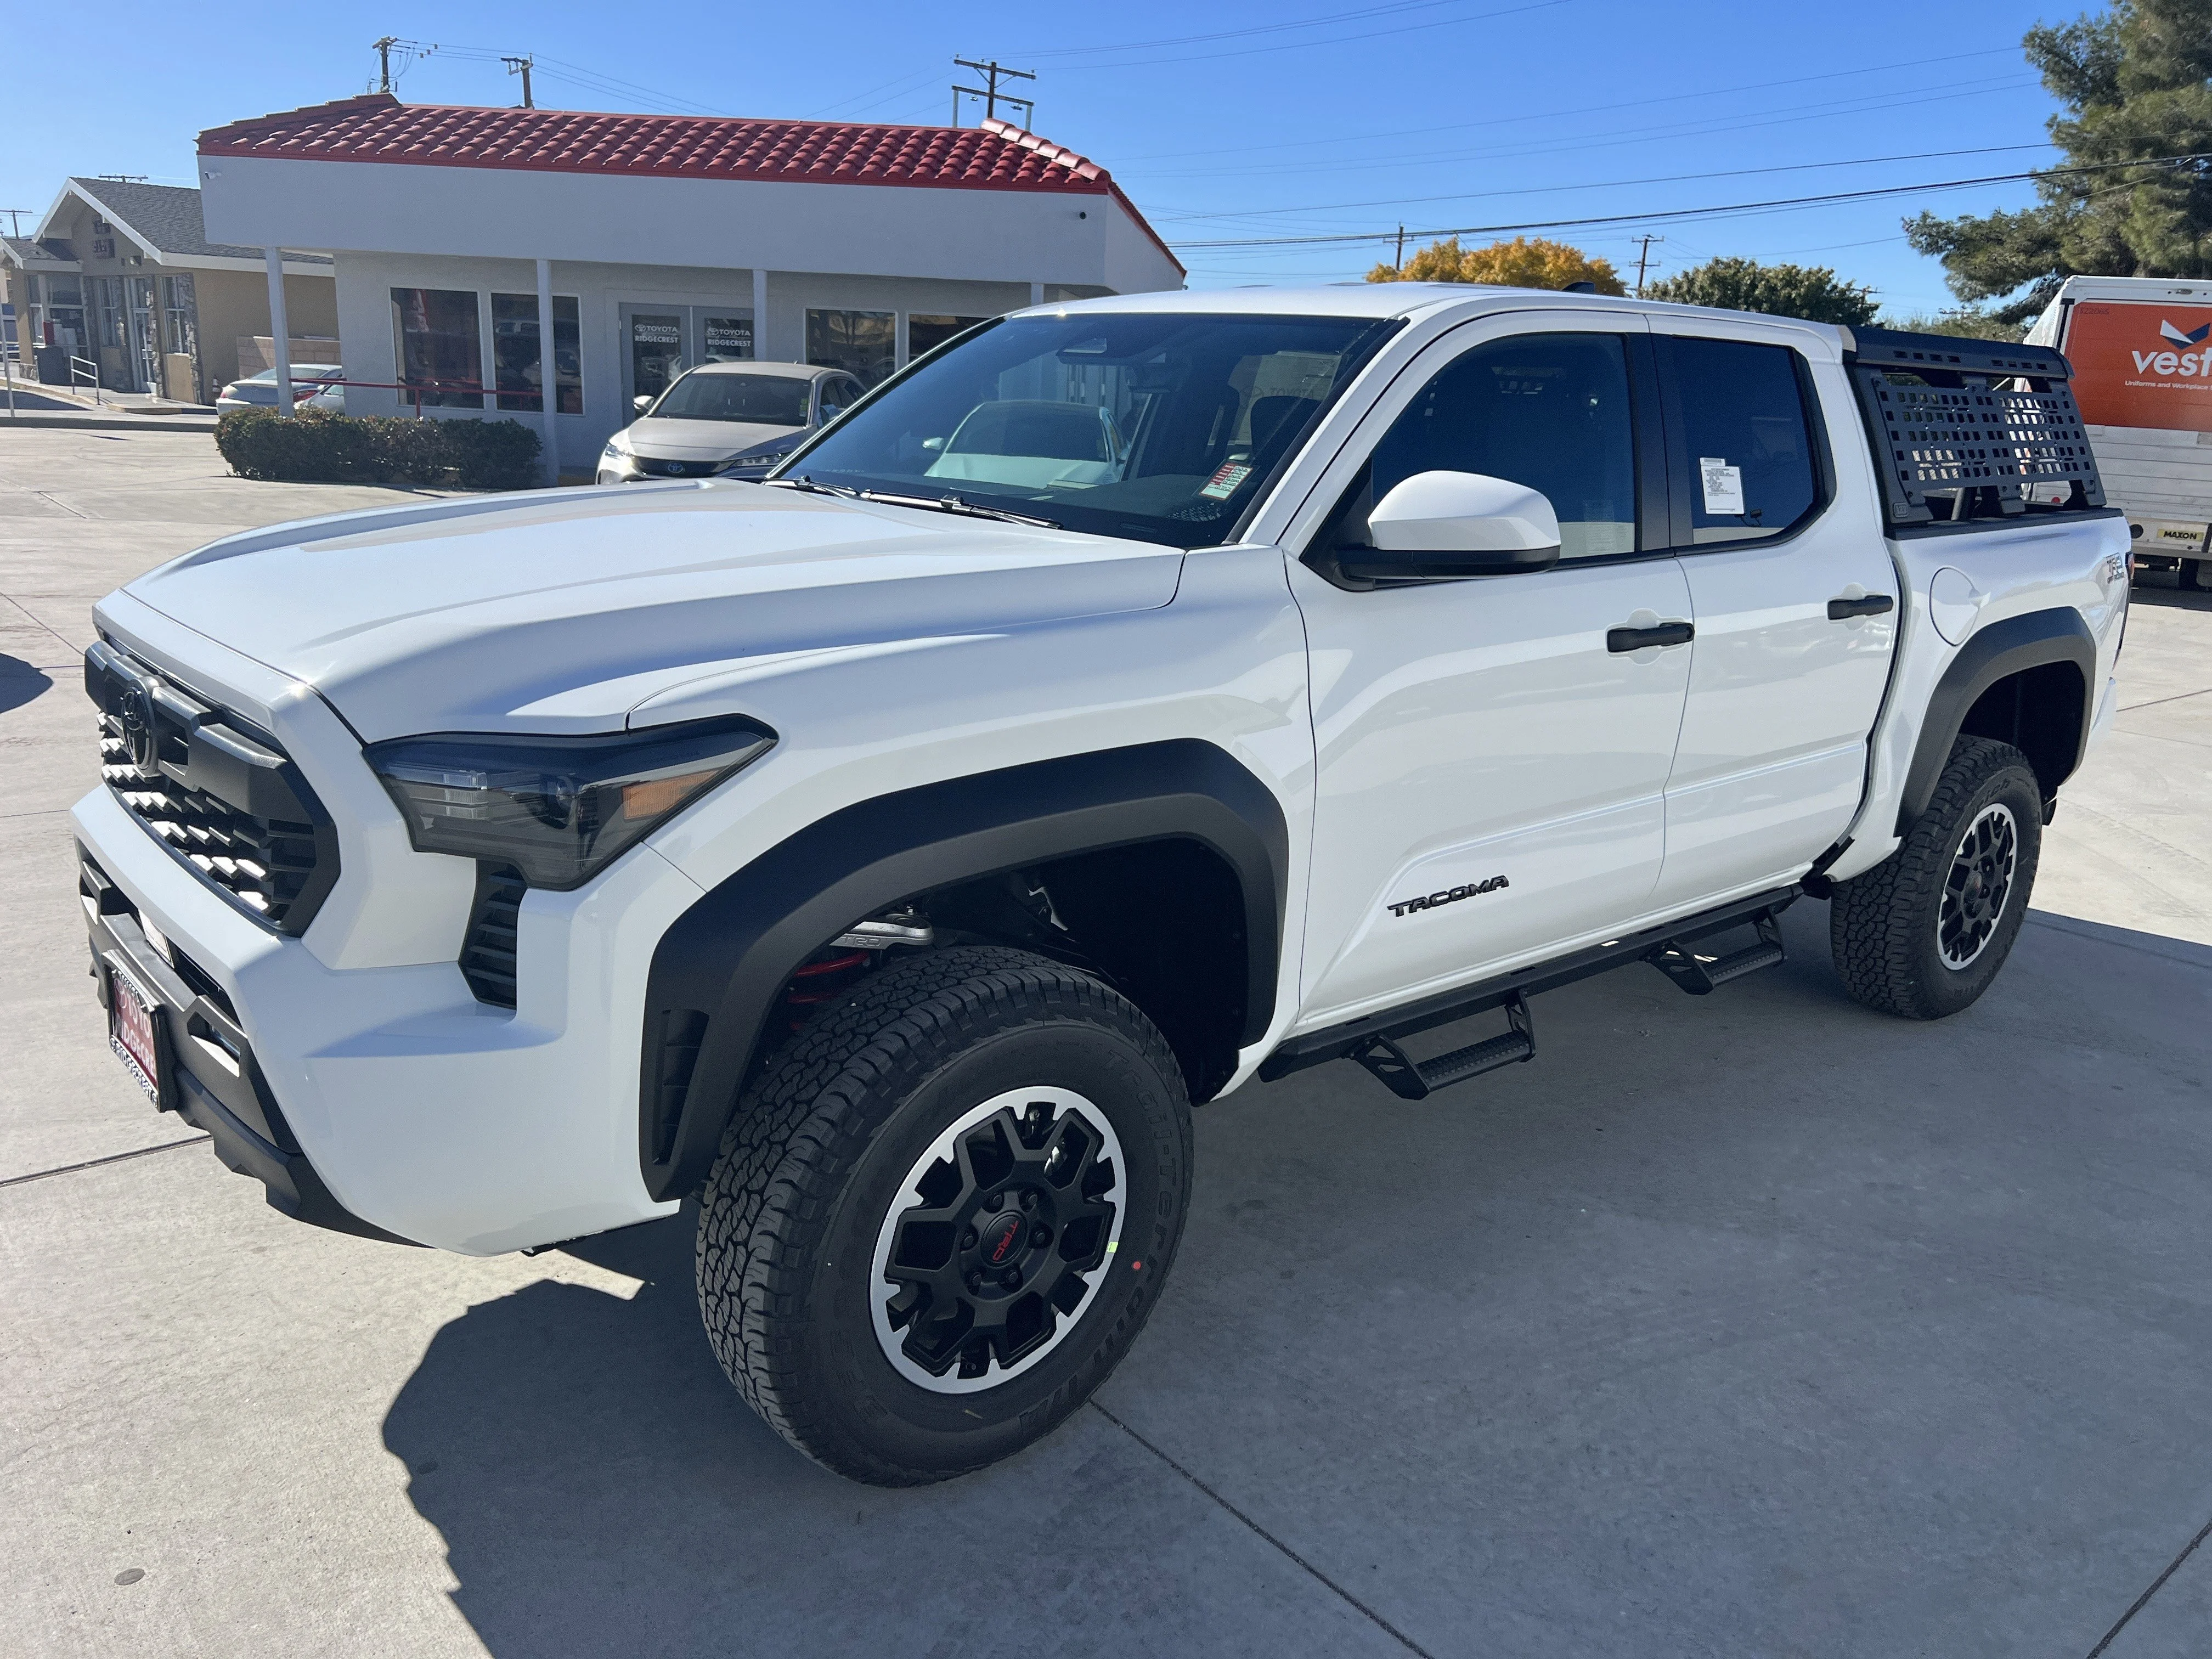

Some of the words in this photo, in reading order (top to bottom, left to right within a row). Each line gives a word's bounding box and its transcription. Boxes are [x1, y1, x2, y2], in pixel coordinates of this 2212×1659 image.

[2163, 531, 2197, 540] MAXON
[1387, 874, 1509, 917] TACOMA
[840, 936, 881, 947] TRD
[127, 989, 150, 1039] TOYO
[992, 1220, 1019, 1261] TRD
